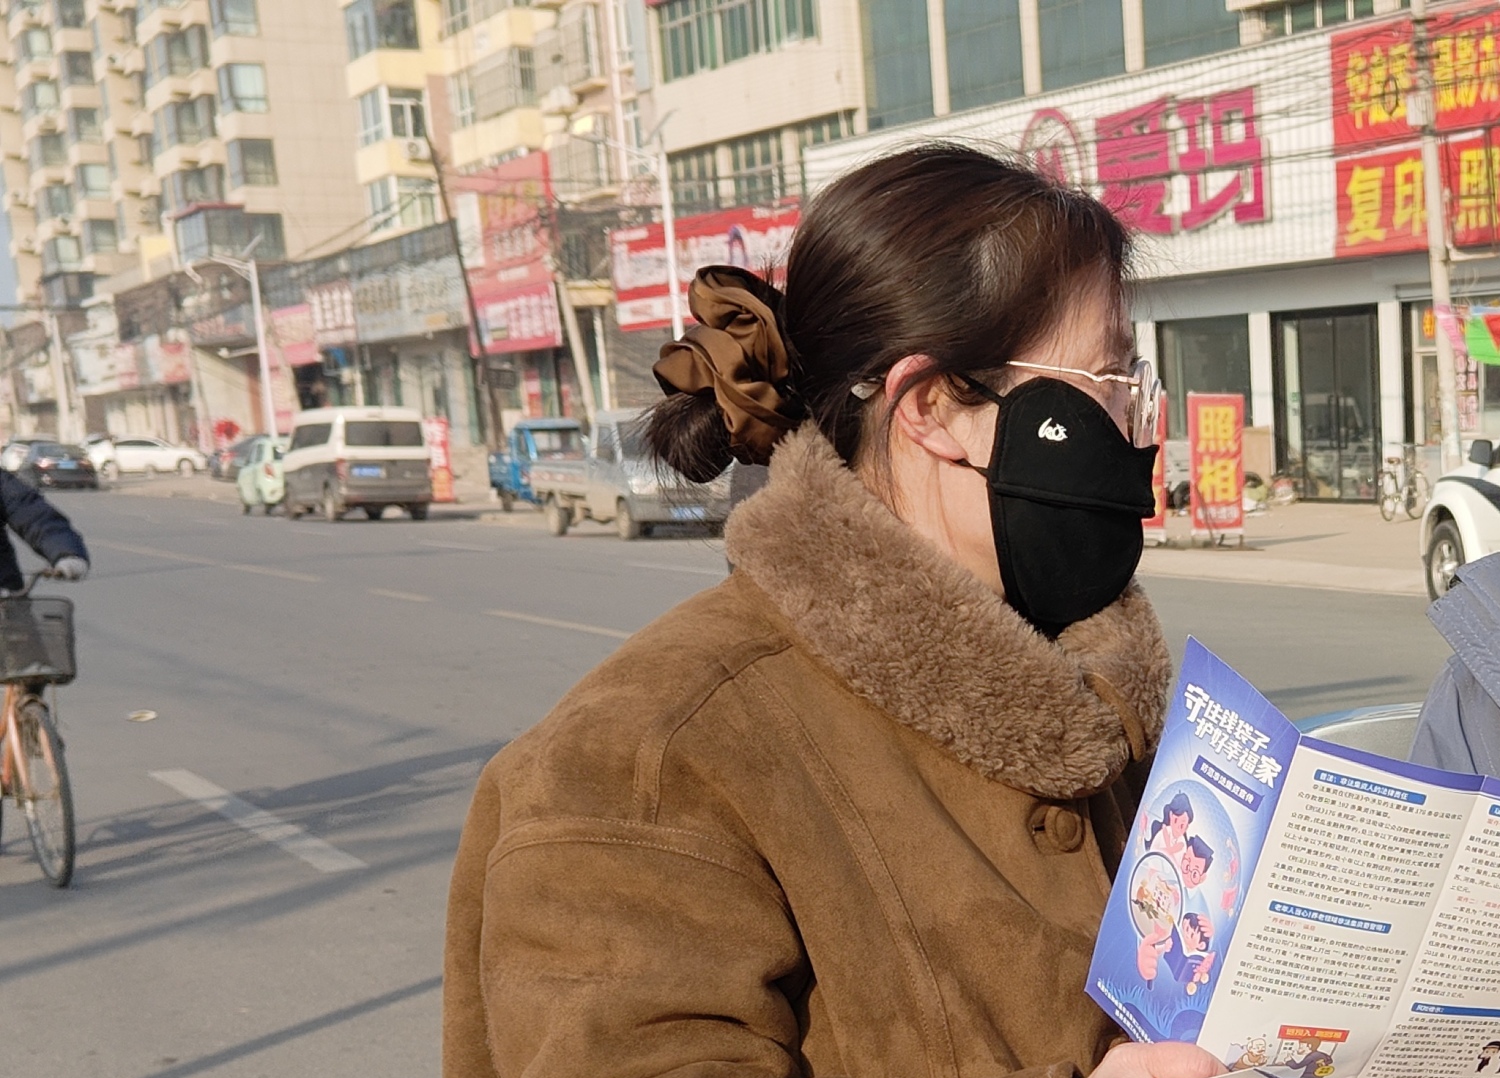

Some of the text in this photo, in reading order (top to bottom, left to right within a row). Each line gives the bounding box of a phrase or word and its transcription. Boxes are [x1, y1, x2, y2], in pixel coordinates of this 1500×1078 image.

[1095, 86, 1267, 234] 爱玛
[1196, 405, 1238, 503] 照相
[1184, 683, 1271, 752] 守住钱袋子
[1194, 718, 1283, 788] 护好幸福家
